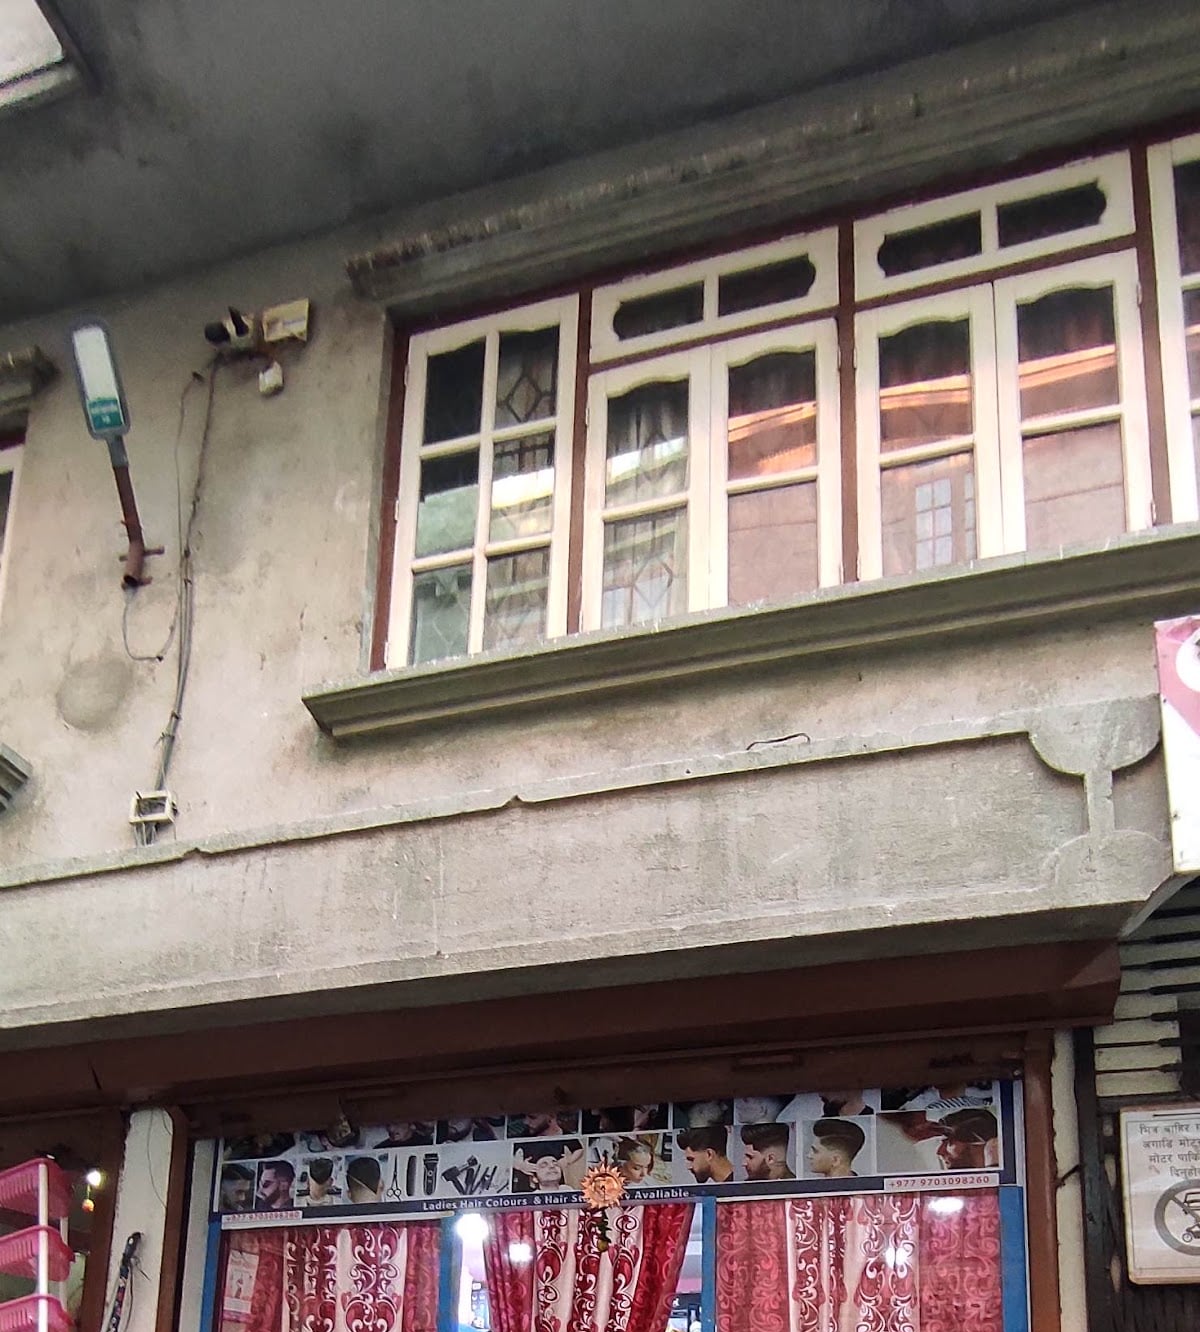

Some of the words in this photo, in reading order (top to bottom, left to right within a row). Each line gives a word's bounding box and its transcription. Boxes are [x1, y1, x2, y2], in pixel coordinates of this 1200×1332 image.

[889, 1179, 916, 1187] +977
[920, 1175, 990, 1186] 9703098260
[423, 1201, 458, 1211] Ladies
[460, 1200, 483, 1209] Hair
[486, 1198, 528, 1208] Colours
[533, 1196, 542, 1205] &
[545, 1194, 568, 1204] Hair
